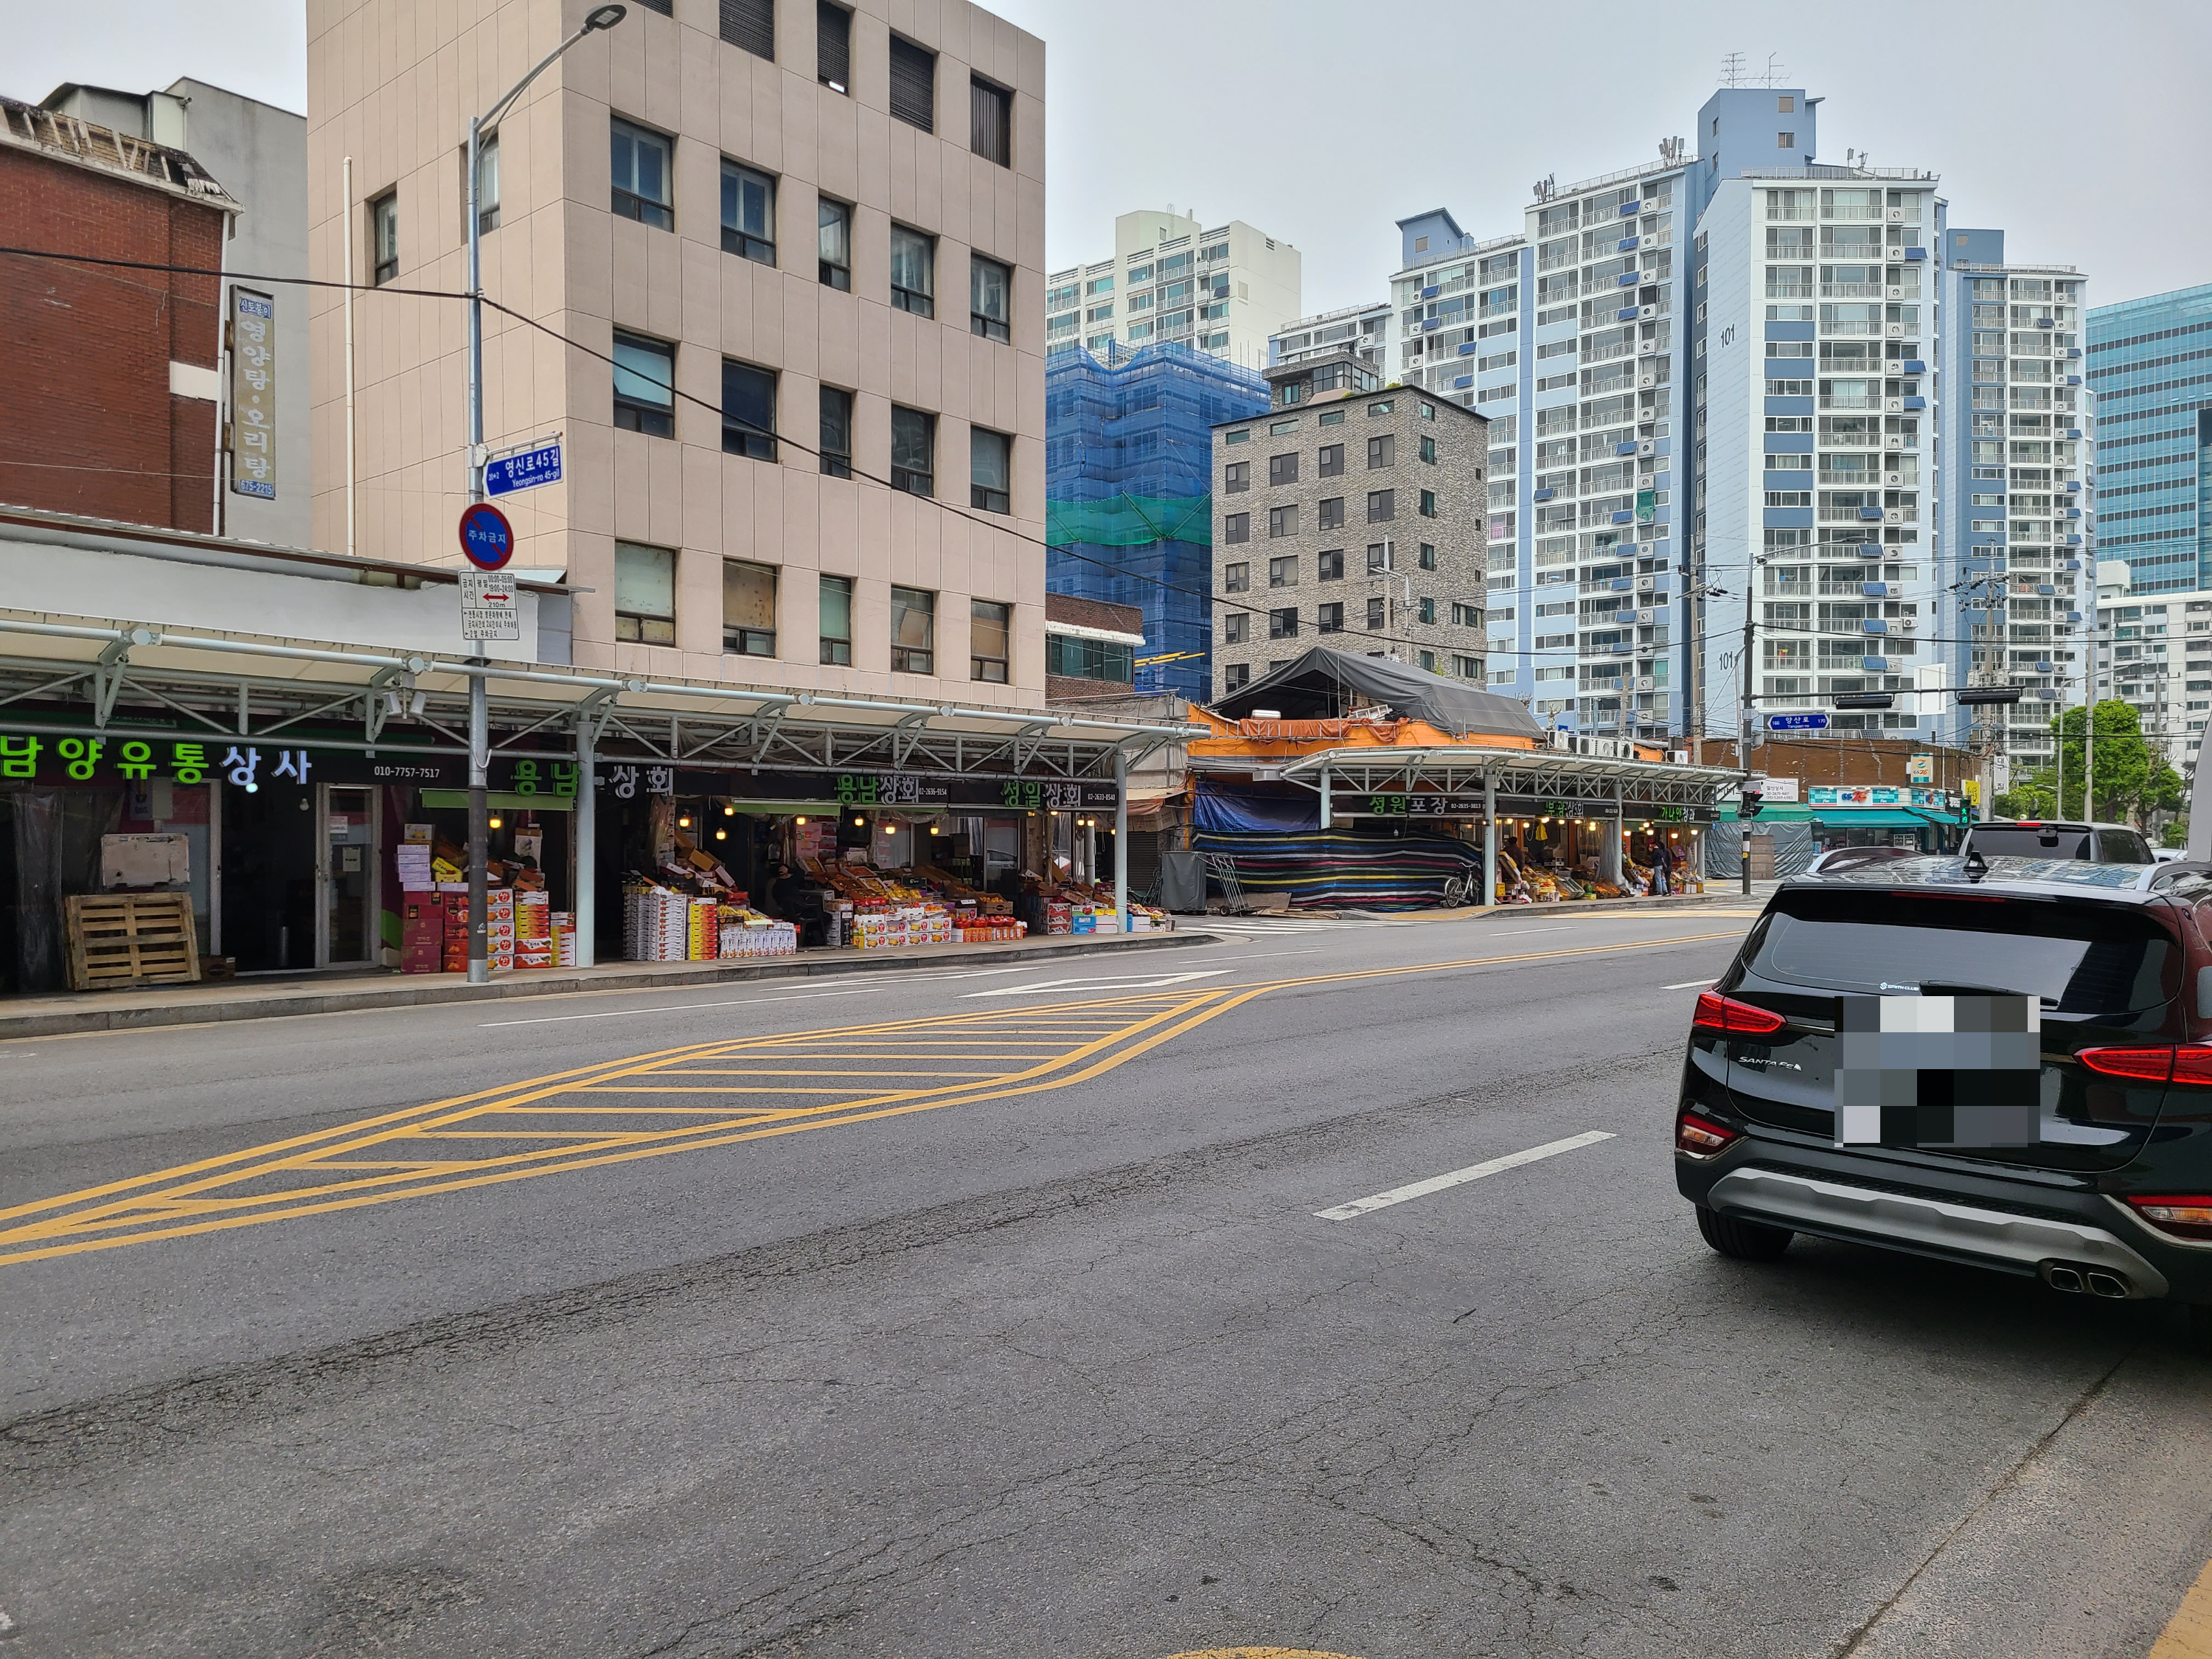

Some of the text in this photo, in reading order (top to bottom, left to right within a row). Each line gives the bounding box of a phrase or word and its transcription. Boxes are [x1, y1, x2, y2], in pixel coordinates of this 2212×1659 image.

[240, 299, 271, 318] 신토불이
[1721, 323, 1734, 348] 101
[505, 448, 559, 479] 영신로45길
[512, 468, 560, 487] Yeongsin-ro 45-gil
[240, 481, 272, 495] 675-2215
[468, 529, 506, 544] 주차금지
[463, 579, 473, 588] 금지
[477, 580, 488, 588] 평일
[464, 591, 474, 599] 시간
[481, 630, 498, 639] 주차금지
[1719, 651, 1733, 671] 101
[375, 766, 439, 779] 010-7757-7517
[919, 787, 947, 796] 02-2636-9154
[1088, 793, 1116, 801] 02-2633-8540
[1842, 790, 1870, 803] GS25
[1738, 1056, 1777, 1067] SANTA
